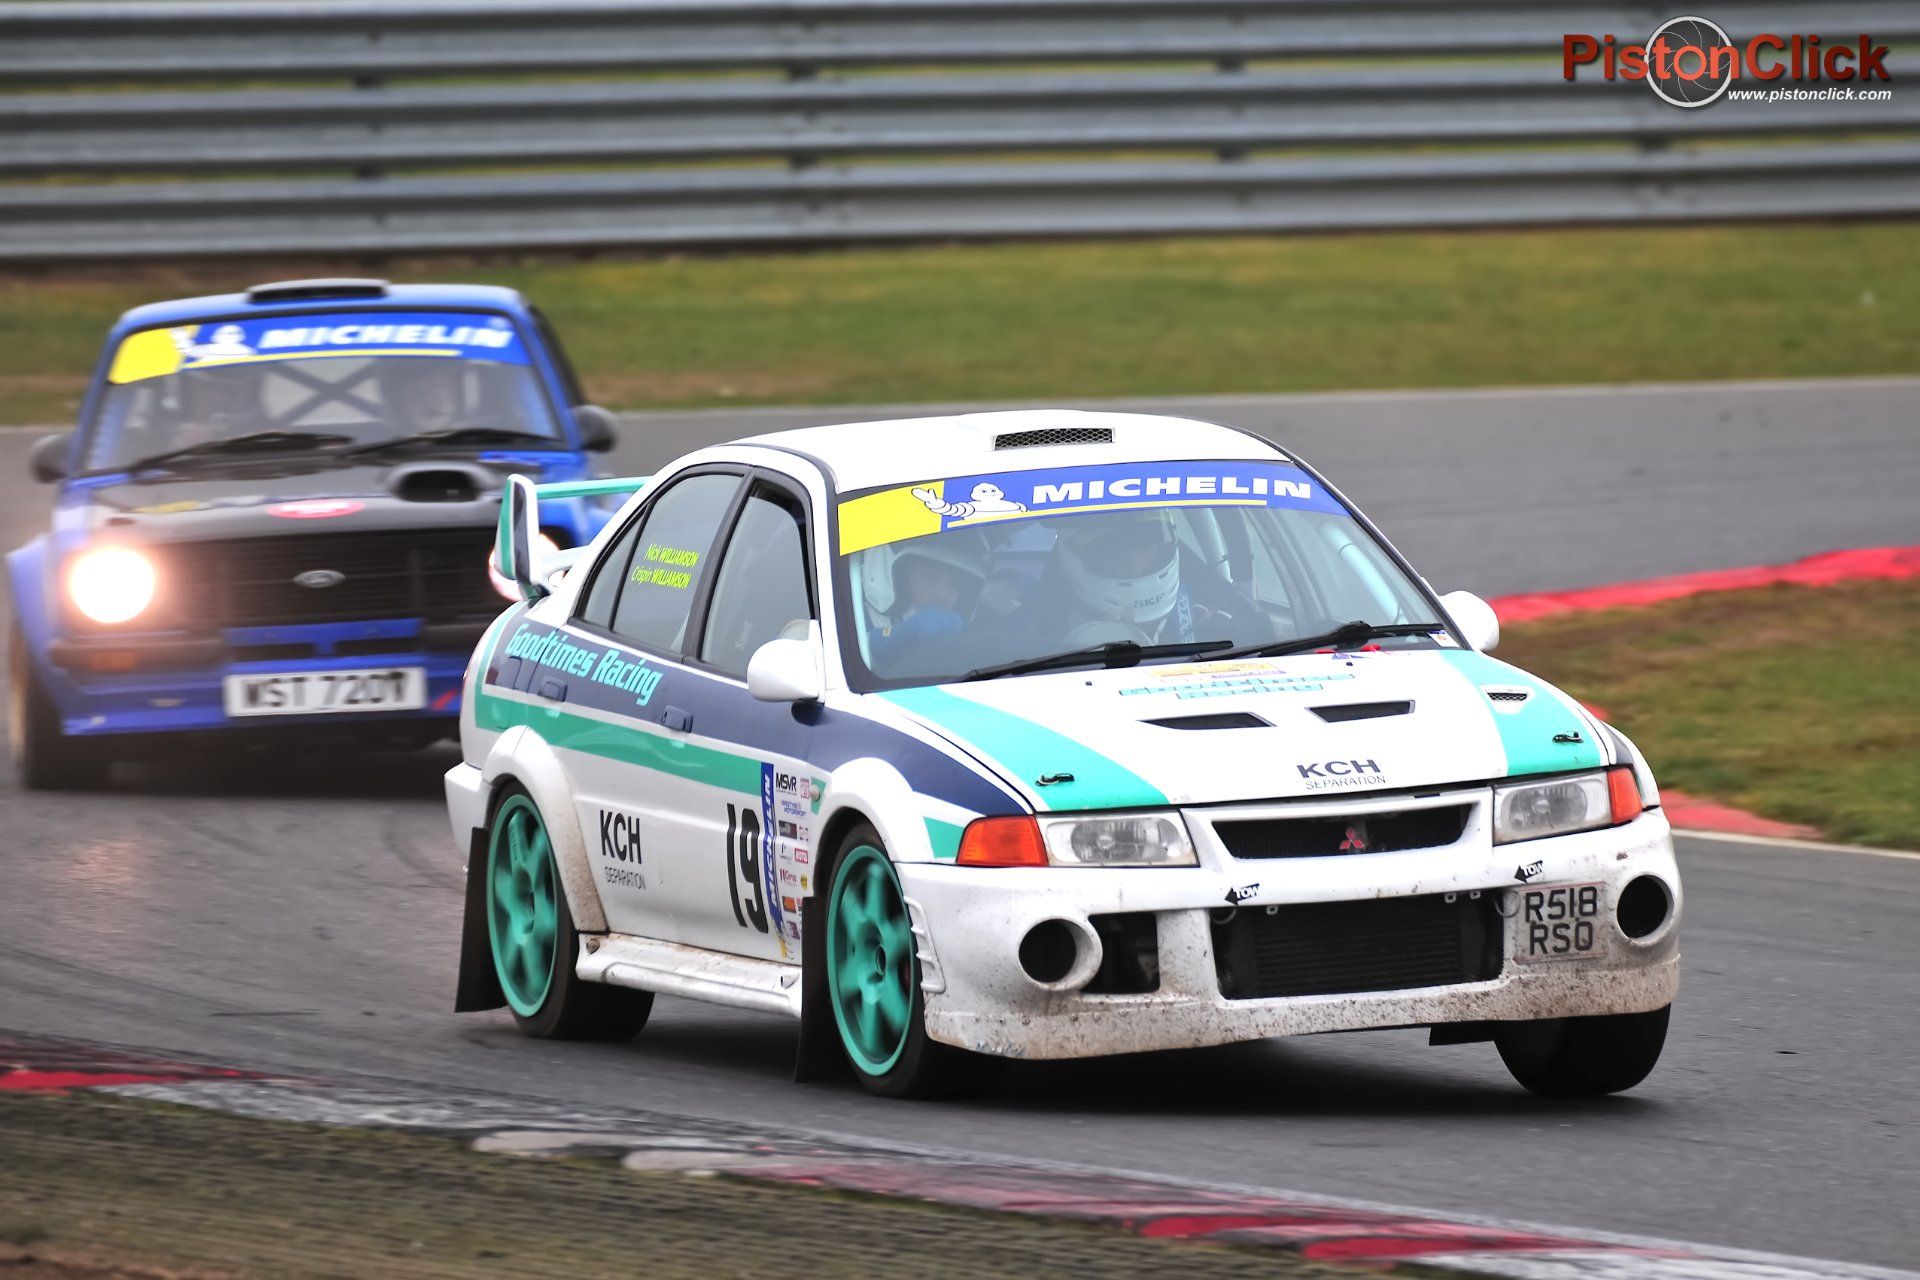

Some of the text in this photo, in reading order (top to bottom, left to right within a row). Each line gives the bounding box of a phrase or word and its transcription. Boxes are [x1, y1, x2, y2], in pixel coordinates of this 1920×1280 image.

[258, 325, 514, 348] MICHELIN
[1032, 476, 1311, 504] MICHELIN
[660, 547, 699, 568] WILLIAMSON
[651, 568, 692, 588] WILLIAMSON
[505, 623, 664, 707] Goodtimes Racing
[1296, 759, 1381, 778] KCH
[776, 772, 797, 792] MSVR
[1305, 775, 1387, 790] SEPARATION
[600, 809, 642, 864] KCH
[604, 866, 647, 890] SEPARATION
[727, 802, 769, 934] 19
[1521, 862, 1543, 877] TOW
[1233, 885, 1260, 899] TOW
[1525, 886, 1598, 922] R518
[1530, 921, 1593, 955] RSO
